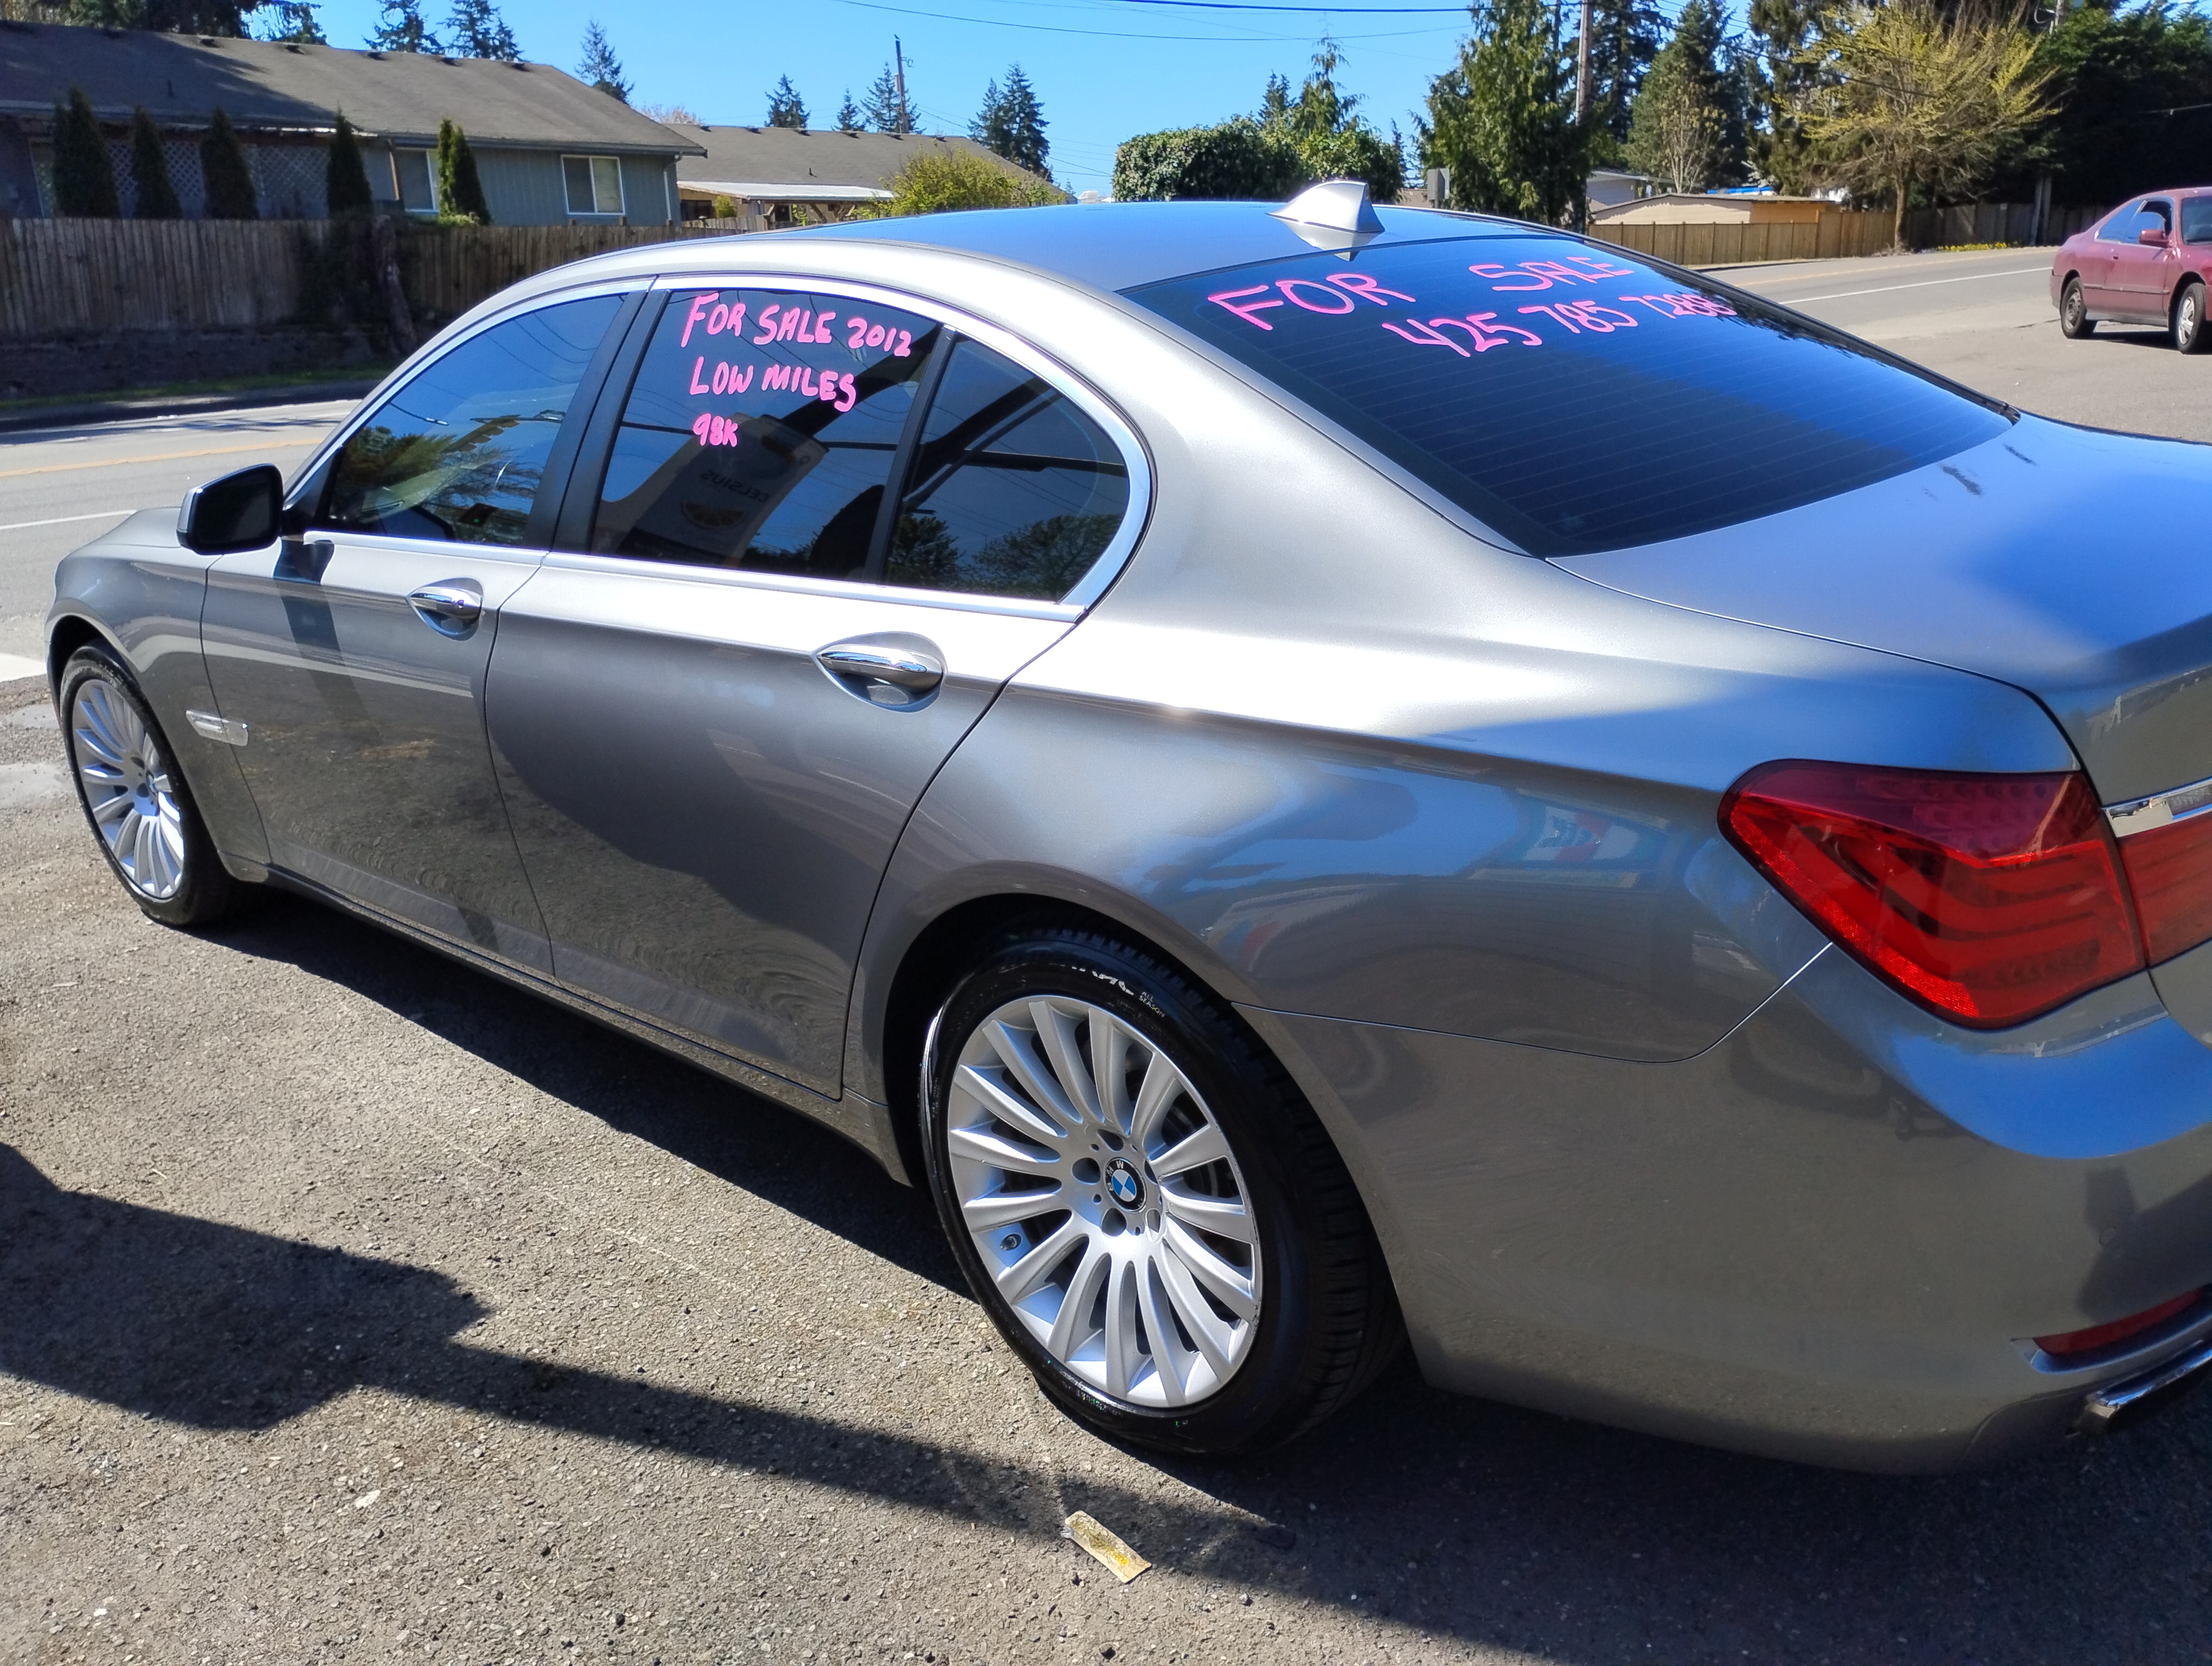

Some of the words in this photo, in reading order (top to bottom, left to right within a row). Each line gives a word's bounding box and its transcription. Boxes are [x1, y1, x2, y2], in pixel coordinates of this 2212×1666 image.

[1207, 273, 1416, 331] FOR
[1468, 257, 1634, 291] SALE
[681, 292, 747, 348] FOR
[753, 304, 837, 345] SALE
[847, 317, 912, 357] 2012
[1381, 312, 1543, 358] 425
[1517, 299, 1638, 334] 785
[1618, 293, 1738, 319] 7288
[689, 356, 754, 396] LOW
[761, 363, 857, 413] MILES
[692, 412, 738, 448] 98K
[1139, 995, 1166, 1018] SEASON
[1141, 991, 1154, 1003] ALL
[1107, 1160, 1124, 1191] BMW
